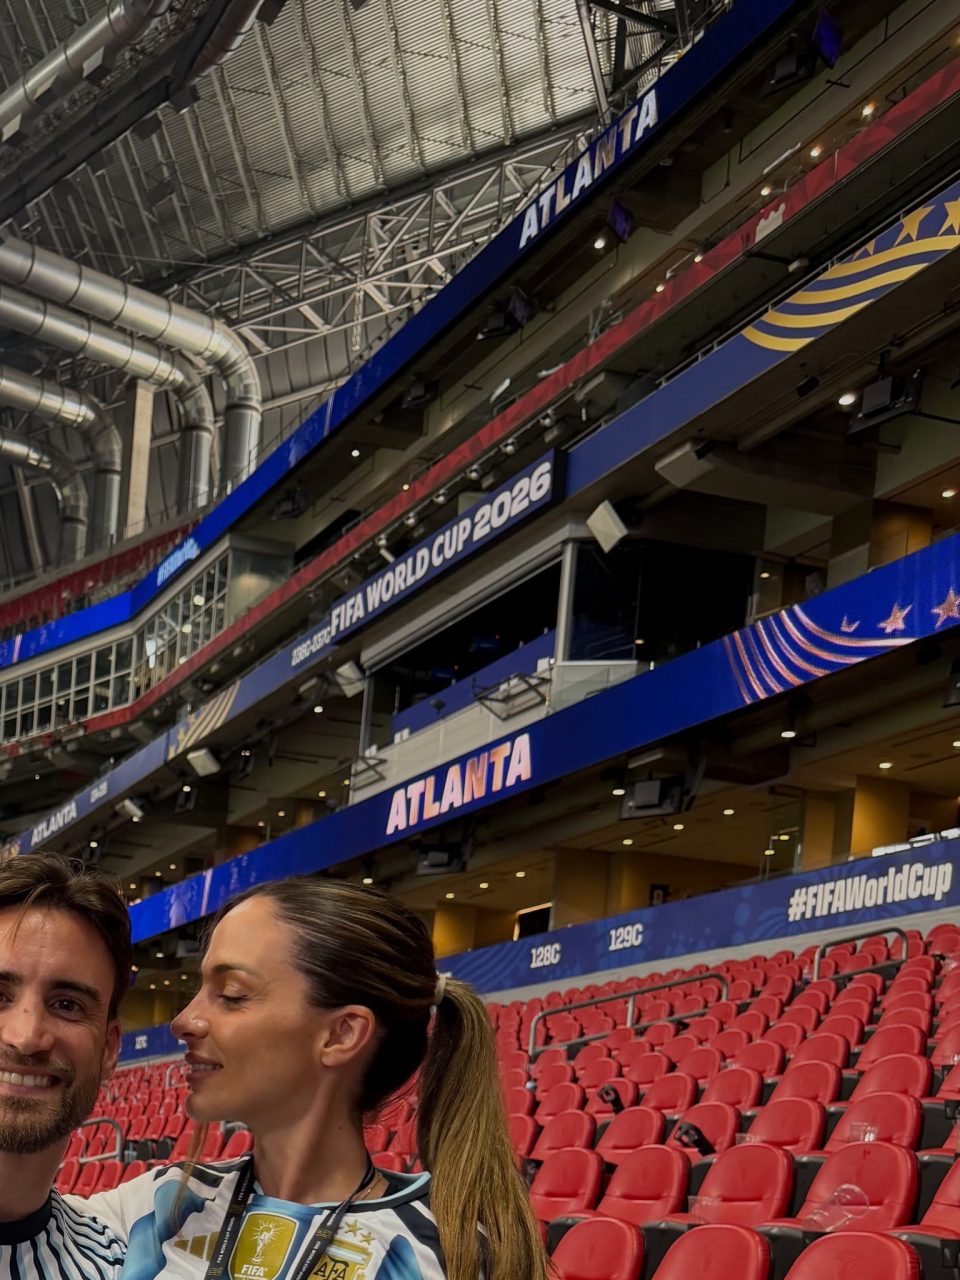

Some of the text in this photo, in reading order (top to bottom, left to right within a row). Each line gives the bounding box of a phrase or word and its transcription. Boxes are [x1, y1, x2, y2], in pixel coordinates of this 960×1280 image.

[519, 89, 658, 249] ATLANTA
[331, 461, 552, 637] FIFA WORLD CUP 2026
[386, 733, 532, 835] ATLANTA
[30, 802, 77, 846] ATLANTA
[788, 862, 953, 922] #FIFAWorldCup
[530, 942, 561, 968] 128C
[608, 923, 643, 951] 129C
[241, 1264, 264, 1277] FIFA
